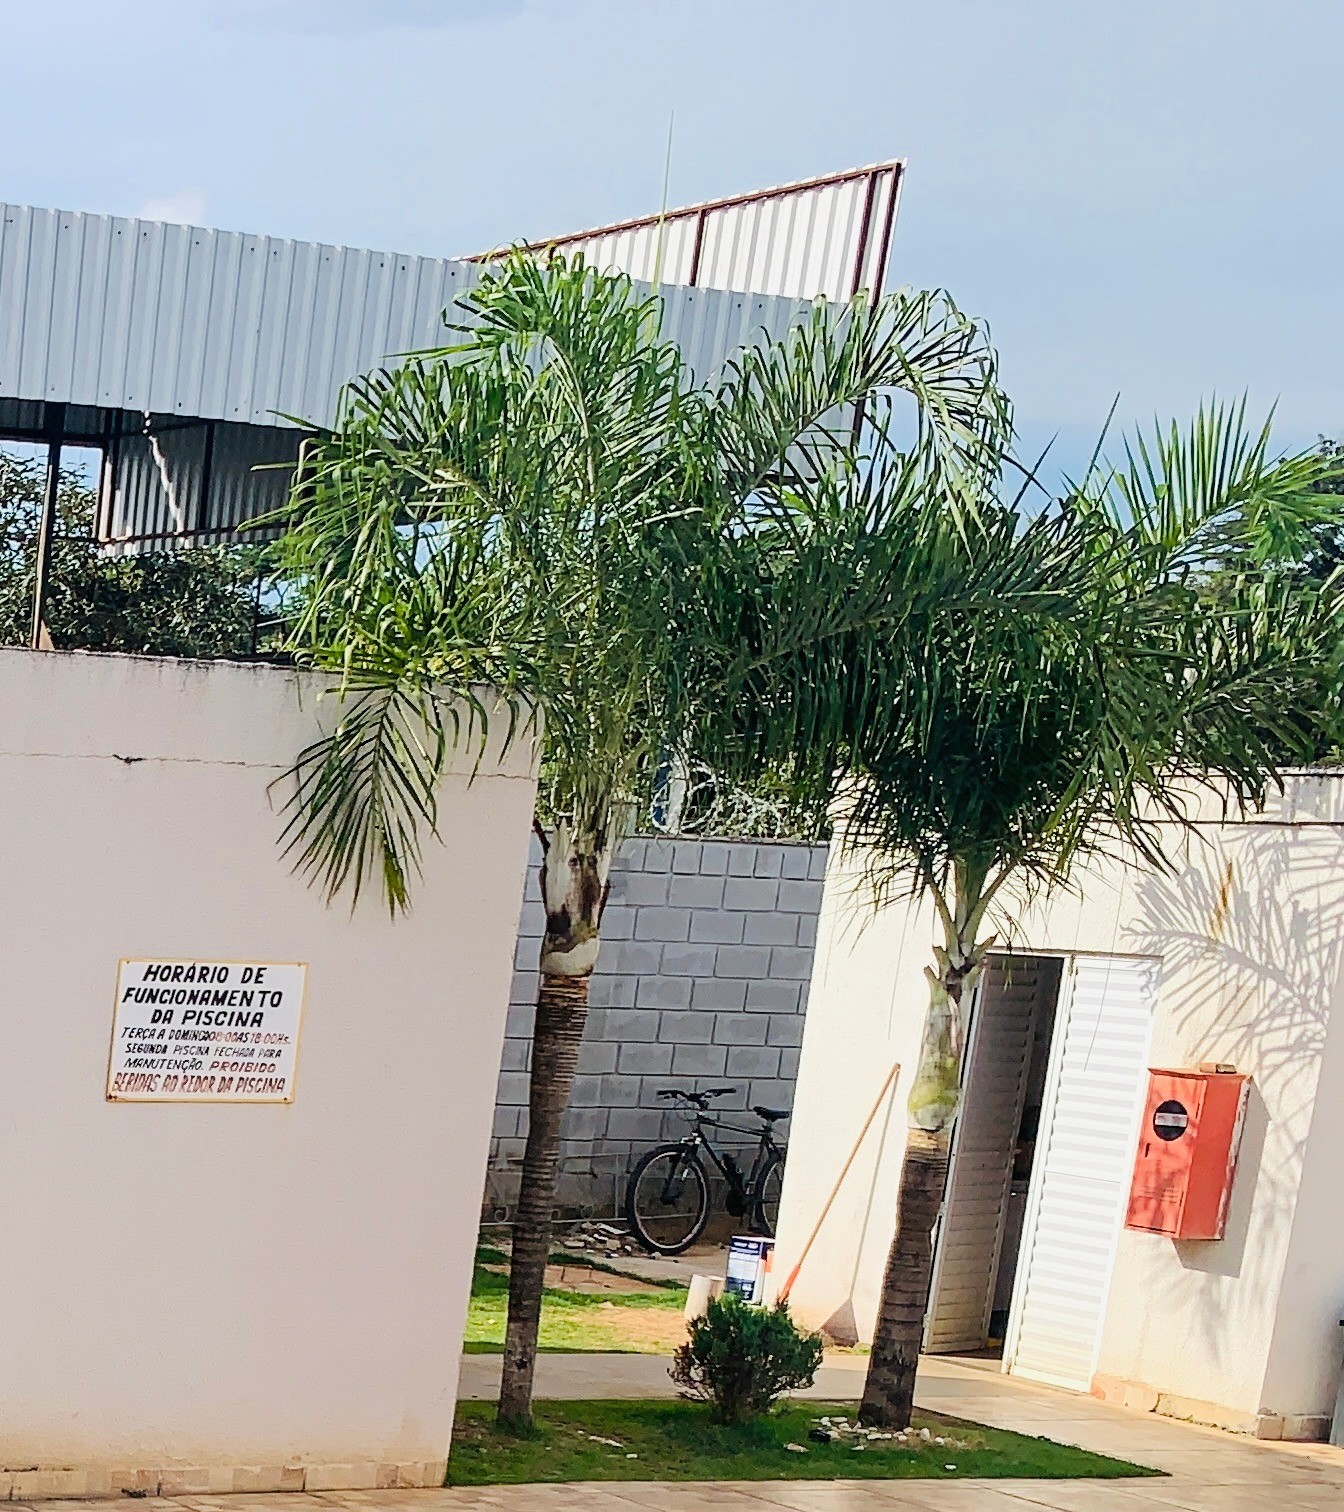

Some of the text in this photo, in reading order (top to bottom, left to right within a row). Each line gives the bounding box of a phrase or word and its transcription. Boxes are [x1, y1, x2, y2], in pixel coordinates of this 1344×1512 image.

[143, 963, 267, 984] HORÁRIO DE
[122, 987, 283, 1008] FUNCIONAMENTO
[150, 1009, 264, 1027] DA PISCINA
[121, 1027, 156, 1040] TERÇA
[157, 1028, 166, 1040] A
[125, 1043, 282, 1058] SEGUNDA PISCINA FECHADA PARA
[209, 1061, 276, 1073] PROIBIDO
[161, 1074, 179, 1092] AO
[217, 1076, 234, 1093] DA
[235, 1077, 286, 1093] PISCINA
